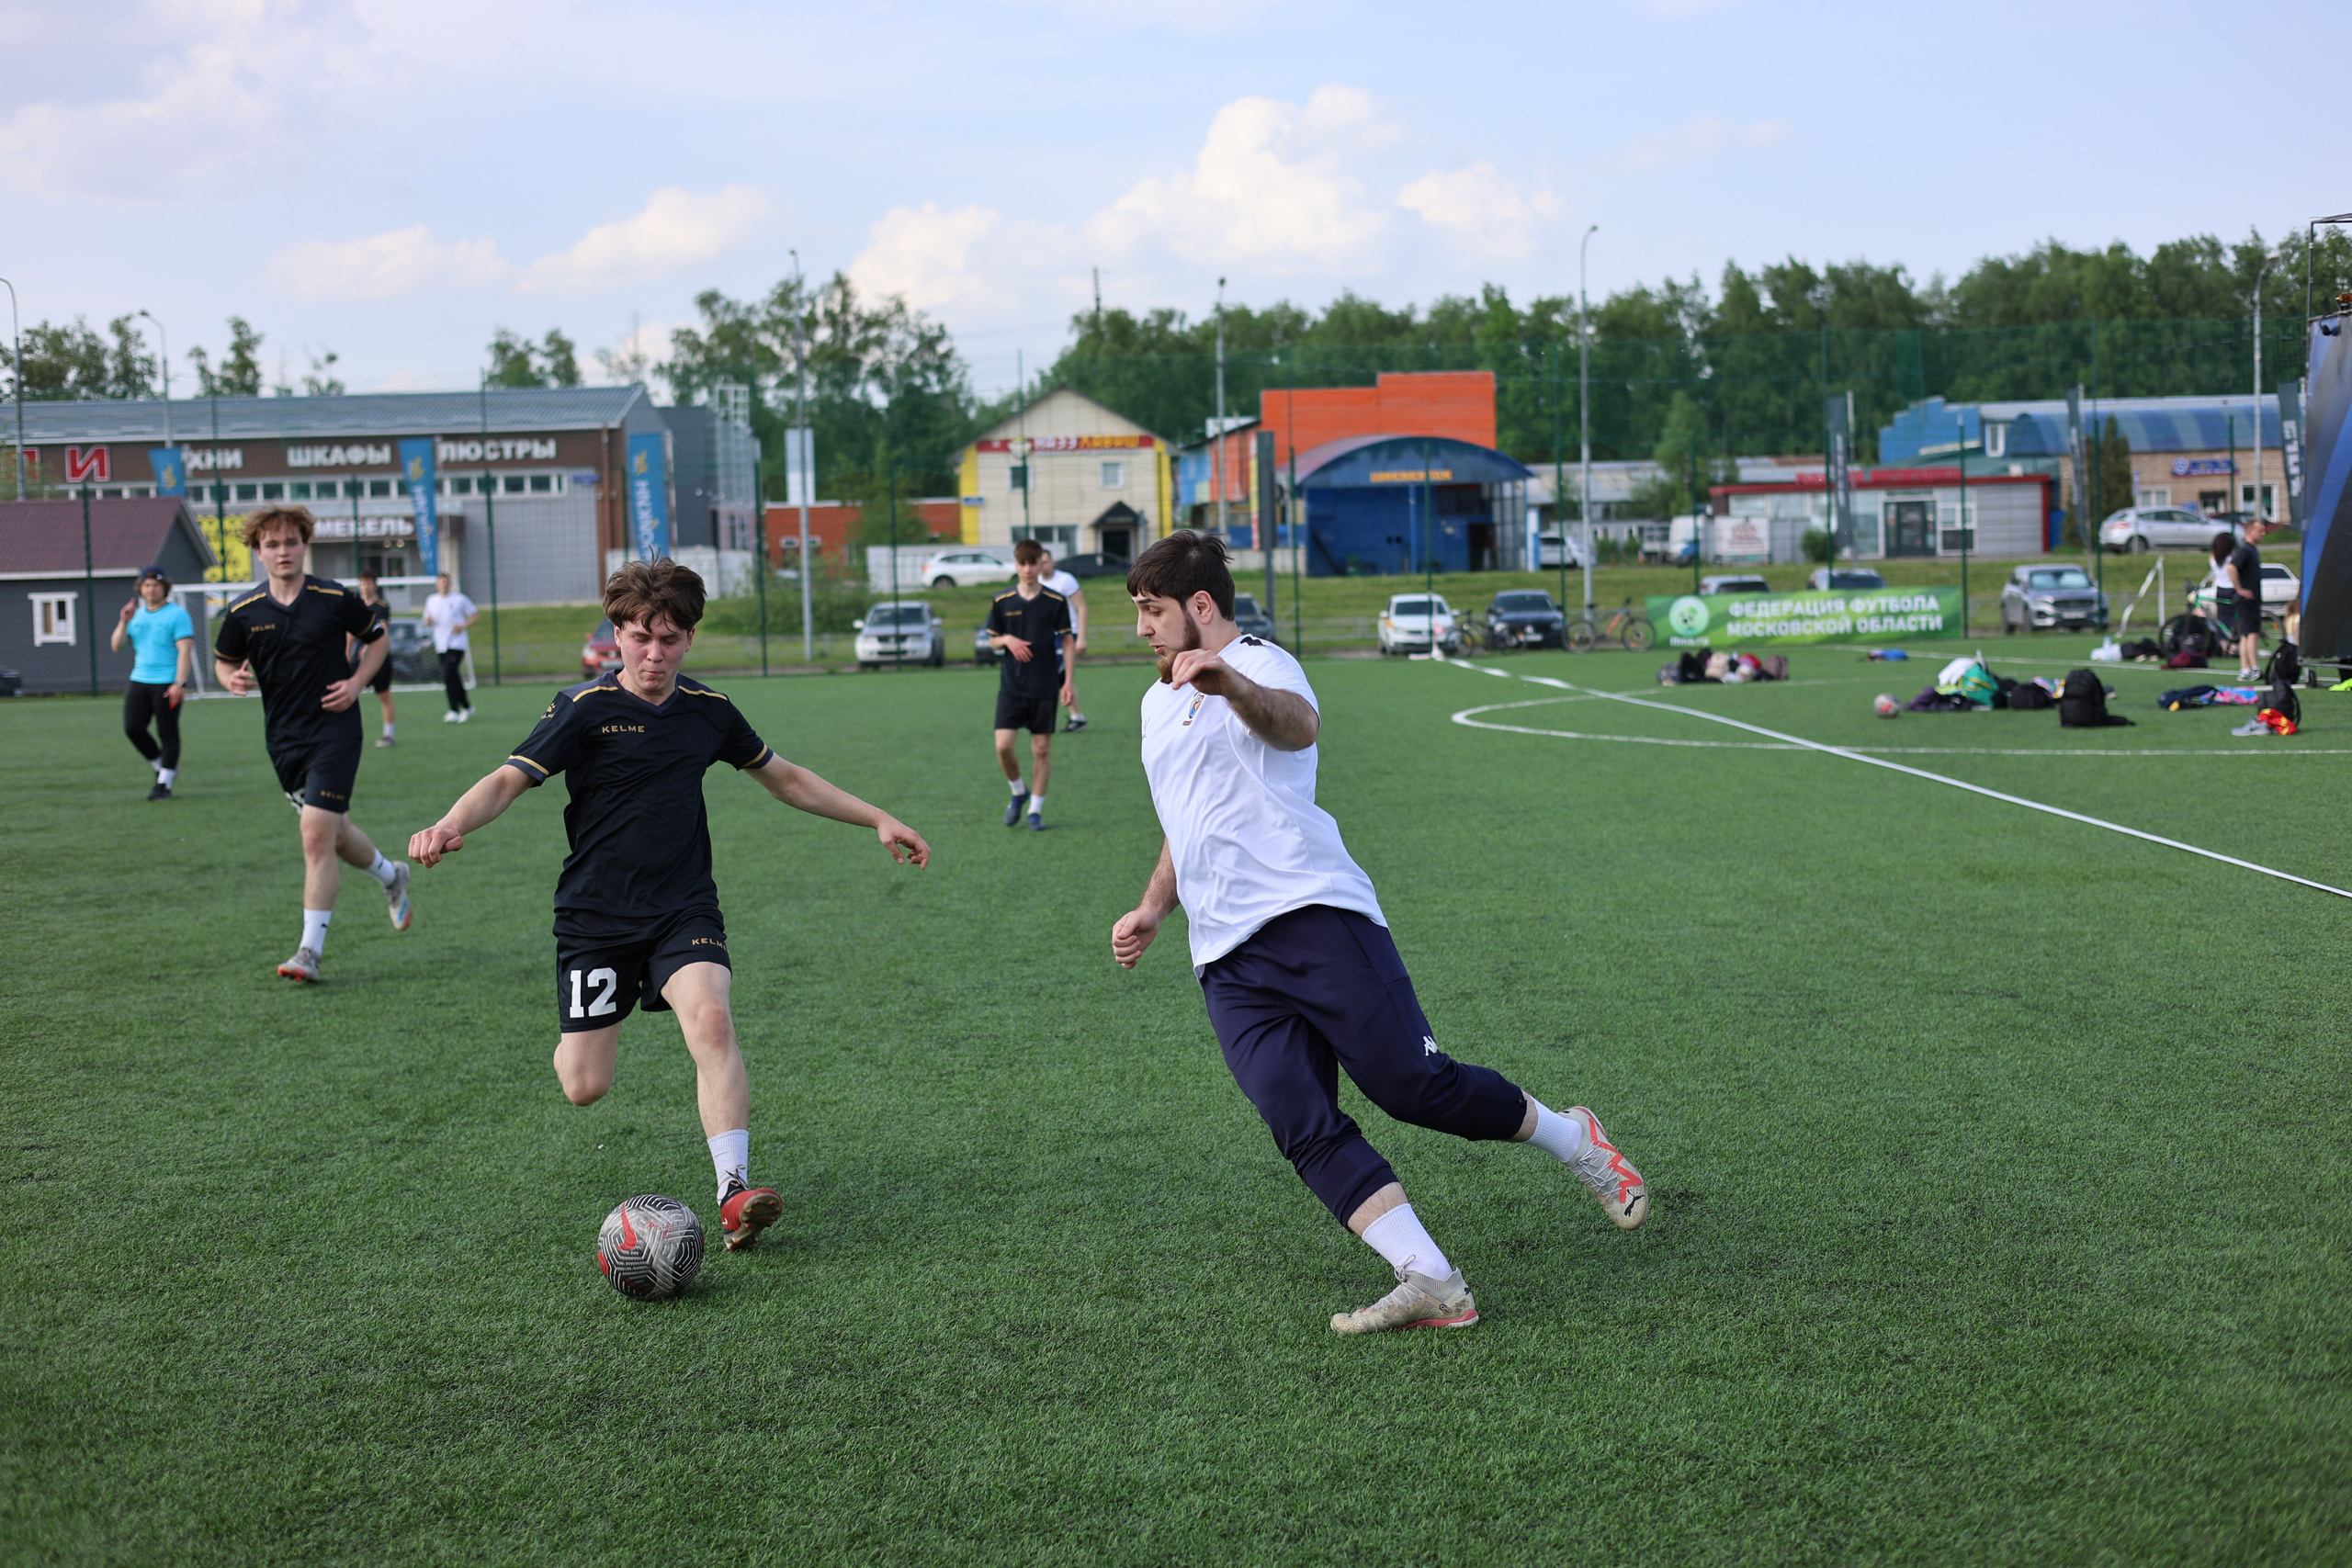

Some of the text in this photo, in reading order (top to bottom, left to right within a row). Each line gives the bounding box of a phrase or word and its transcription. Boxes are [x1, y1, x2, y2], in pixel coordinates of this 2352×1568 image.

[287, 444, 392, 468] ШКАФЫ
[438, 438, 558, 463] ЛЮСТРЫ
[313, 516, 415, 537] МЕБЕЛЬ
[1729, 594, 1939, 618] ФЕДЕРАЦИЯ ФУТБОЛА
[1726, 614, 1943, 637] МОСКОВСКОЙ ОБЛАСТИ
[602, 725, 645, 734] KELME
[570, 967, 616, 1018] 12
